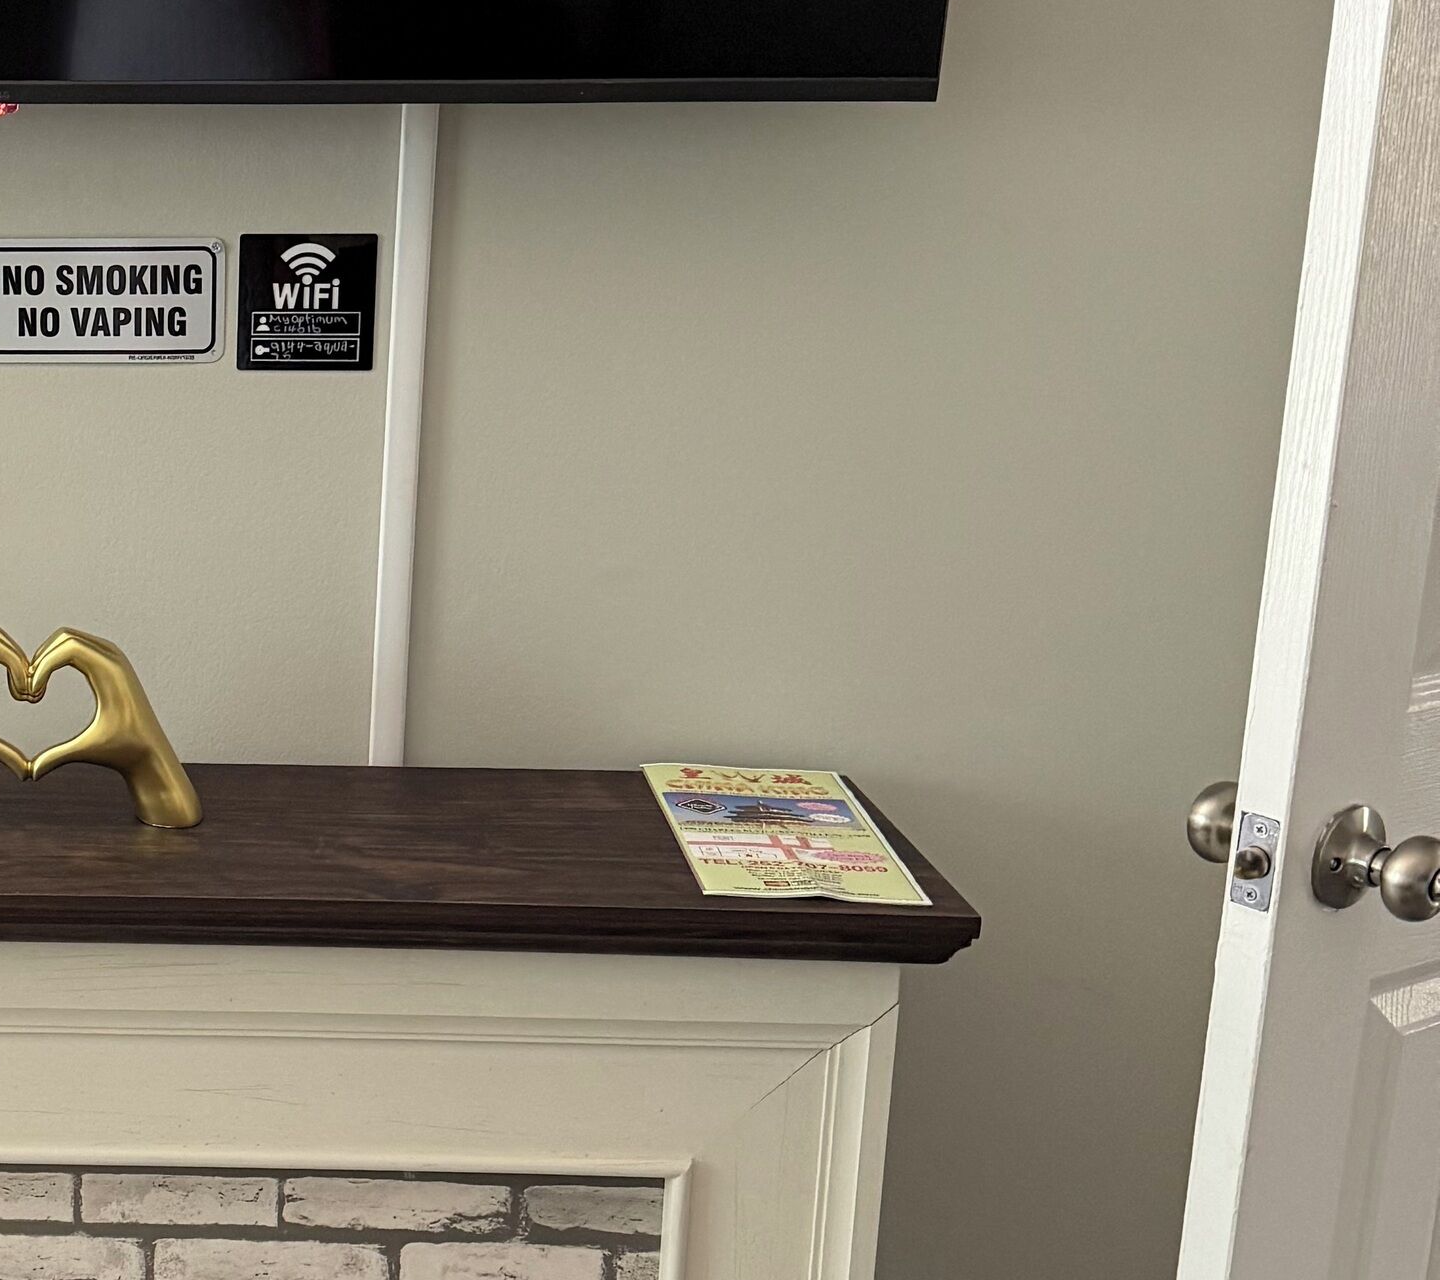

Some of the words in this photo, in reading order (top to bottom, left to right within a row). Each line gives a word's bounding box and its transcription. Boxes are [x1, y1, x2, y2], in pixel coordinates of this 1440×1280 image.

[2, 265, 45, 296] NO
[55, 264, 203, 296] SMOKING
[272, 274, 341, 310] WiFi
[17, 307, 60, 337] NO
[70, 307, 187, 337] VAPING
